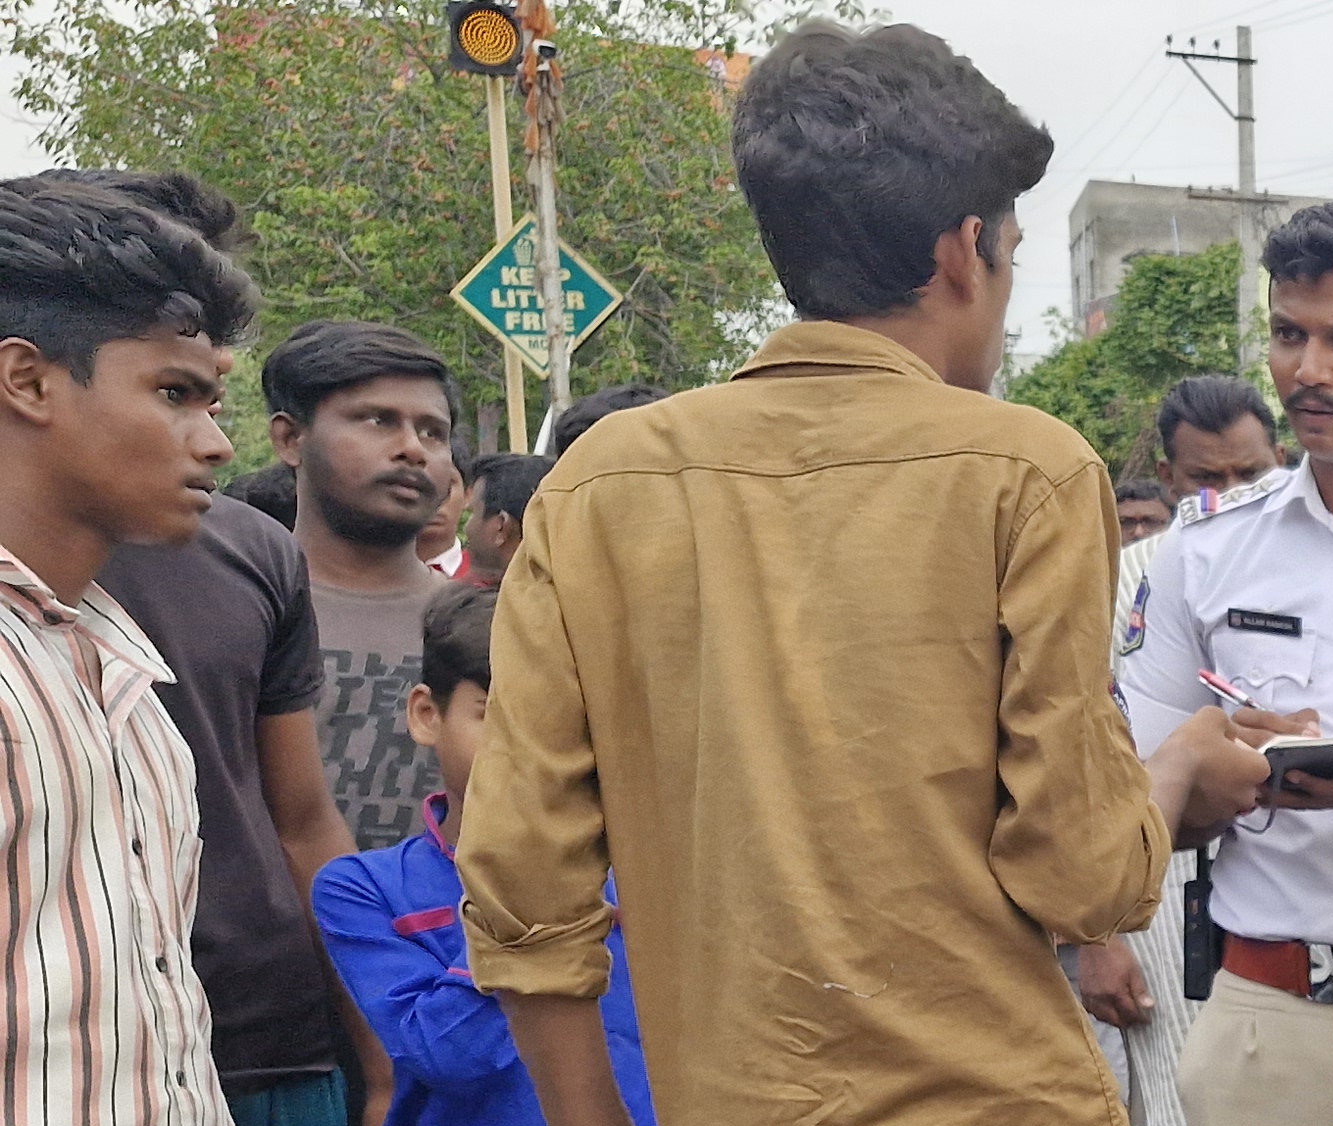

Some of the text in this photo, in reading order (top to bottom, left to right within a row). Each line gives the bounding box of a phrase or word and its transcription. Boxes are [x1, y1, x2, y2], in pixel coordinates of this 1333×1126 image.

[501, 265, 572, 287] KEP
[491, 287, 586, 311] LITTR
[505, 310, 575, 332] FRE
